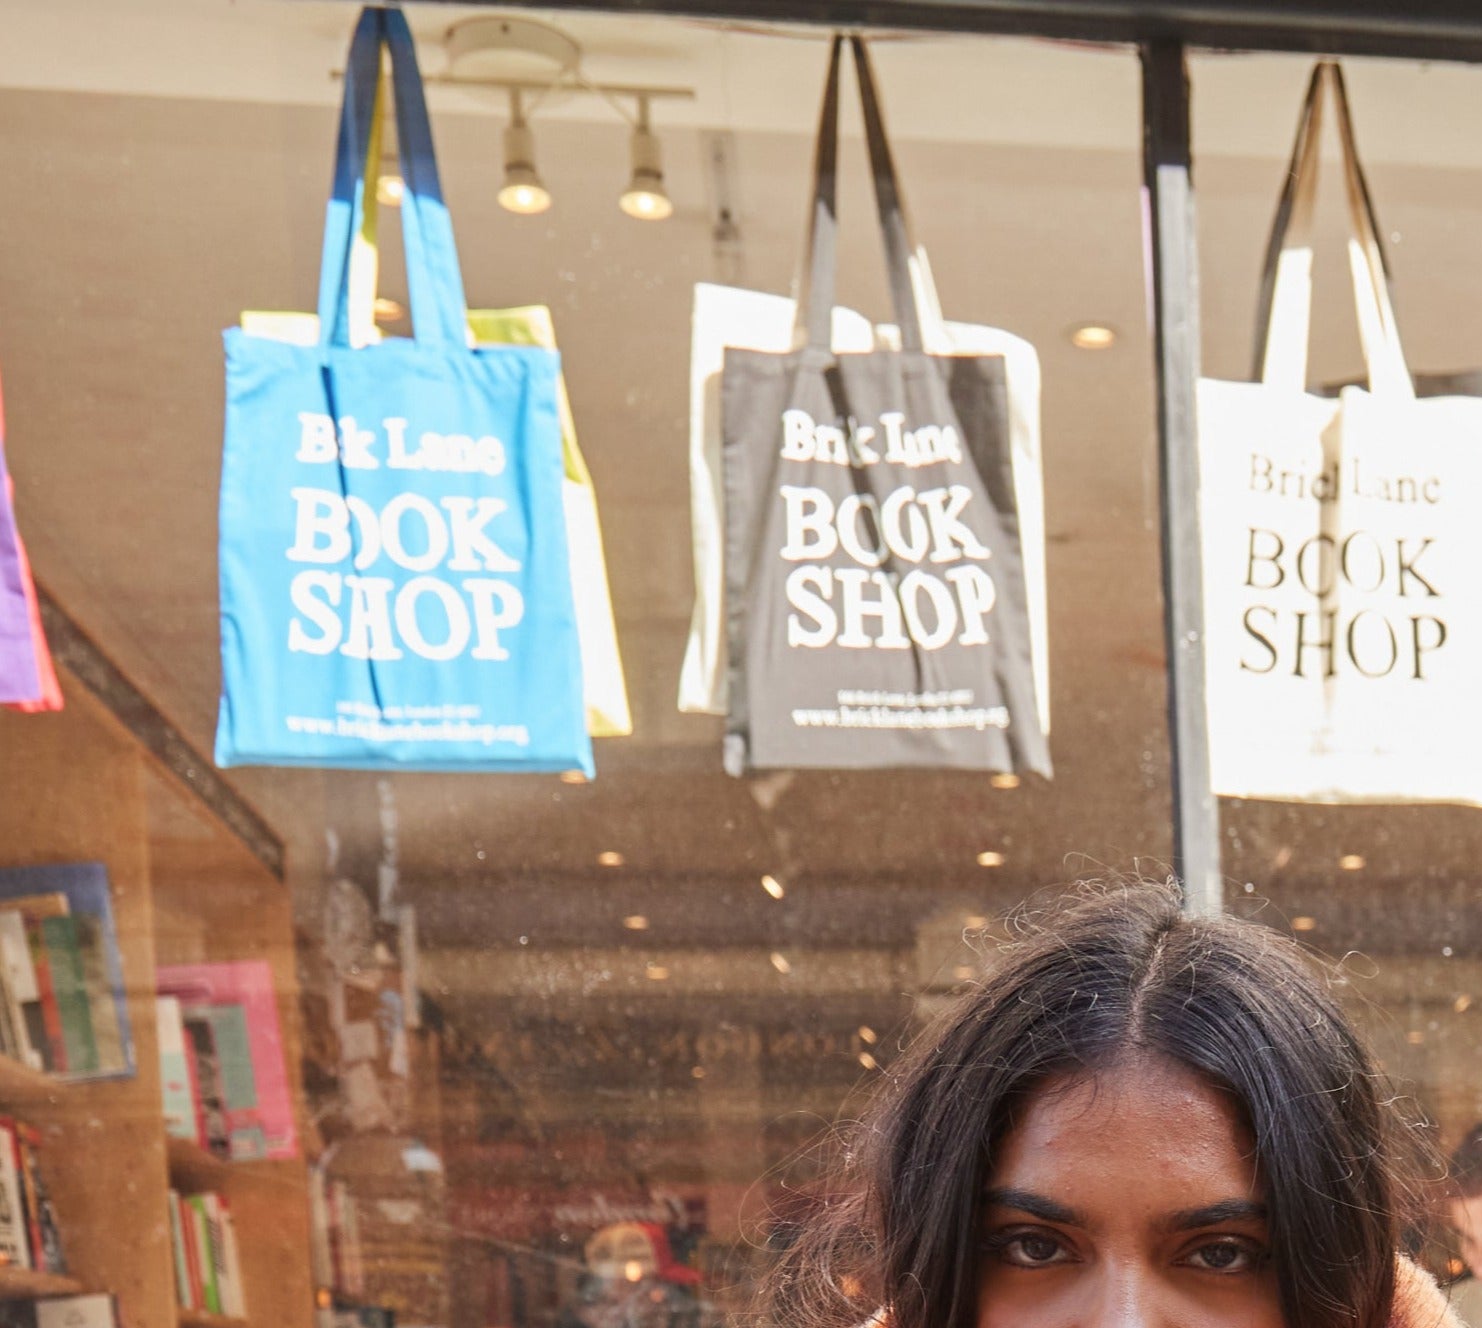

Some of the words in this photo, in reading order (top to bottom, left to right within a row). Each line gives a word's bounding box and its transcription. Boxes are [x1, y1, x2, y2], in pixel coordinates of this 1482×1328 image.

[1351, 456, 1442, 505] Lane
[780, 485, 992, 567] BOOK
[1243, 526, 1442, 599] BOOK
[288, 569, 525, 661] SHOP
[786, 563, 996, 651] SHOP
[1239, 604, 1448, 681] SHOP
